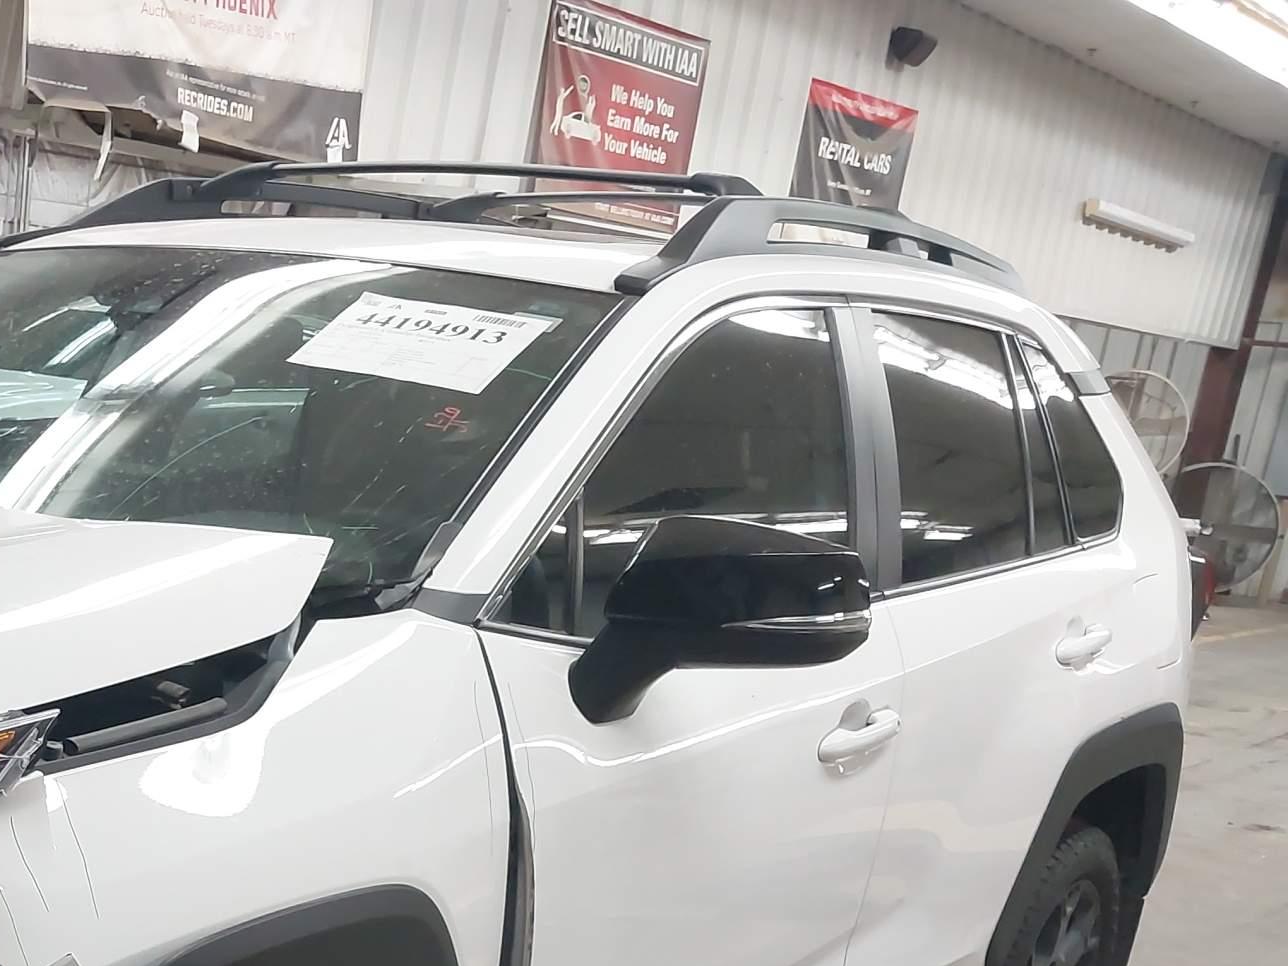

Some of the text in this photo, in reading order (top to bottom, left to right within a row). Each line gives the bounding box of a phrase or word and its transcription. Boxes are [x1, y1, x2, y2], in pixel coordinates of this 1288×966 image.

[558, 9, 698, 79] SELL SMART WITH IAA
[177, 87, 254, 123] RECRIDES.COM
[611, 83, 675, 118] We Help You
[607, 108, 680, 144] Earn More For
[604, 133, 667, 165] Your Vehicle
[818, 136, 892, 175] RENTAL CARS
[357, 313, 508, 344] 44194913
